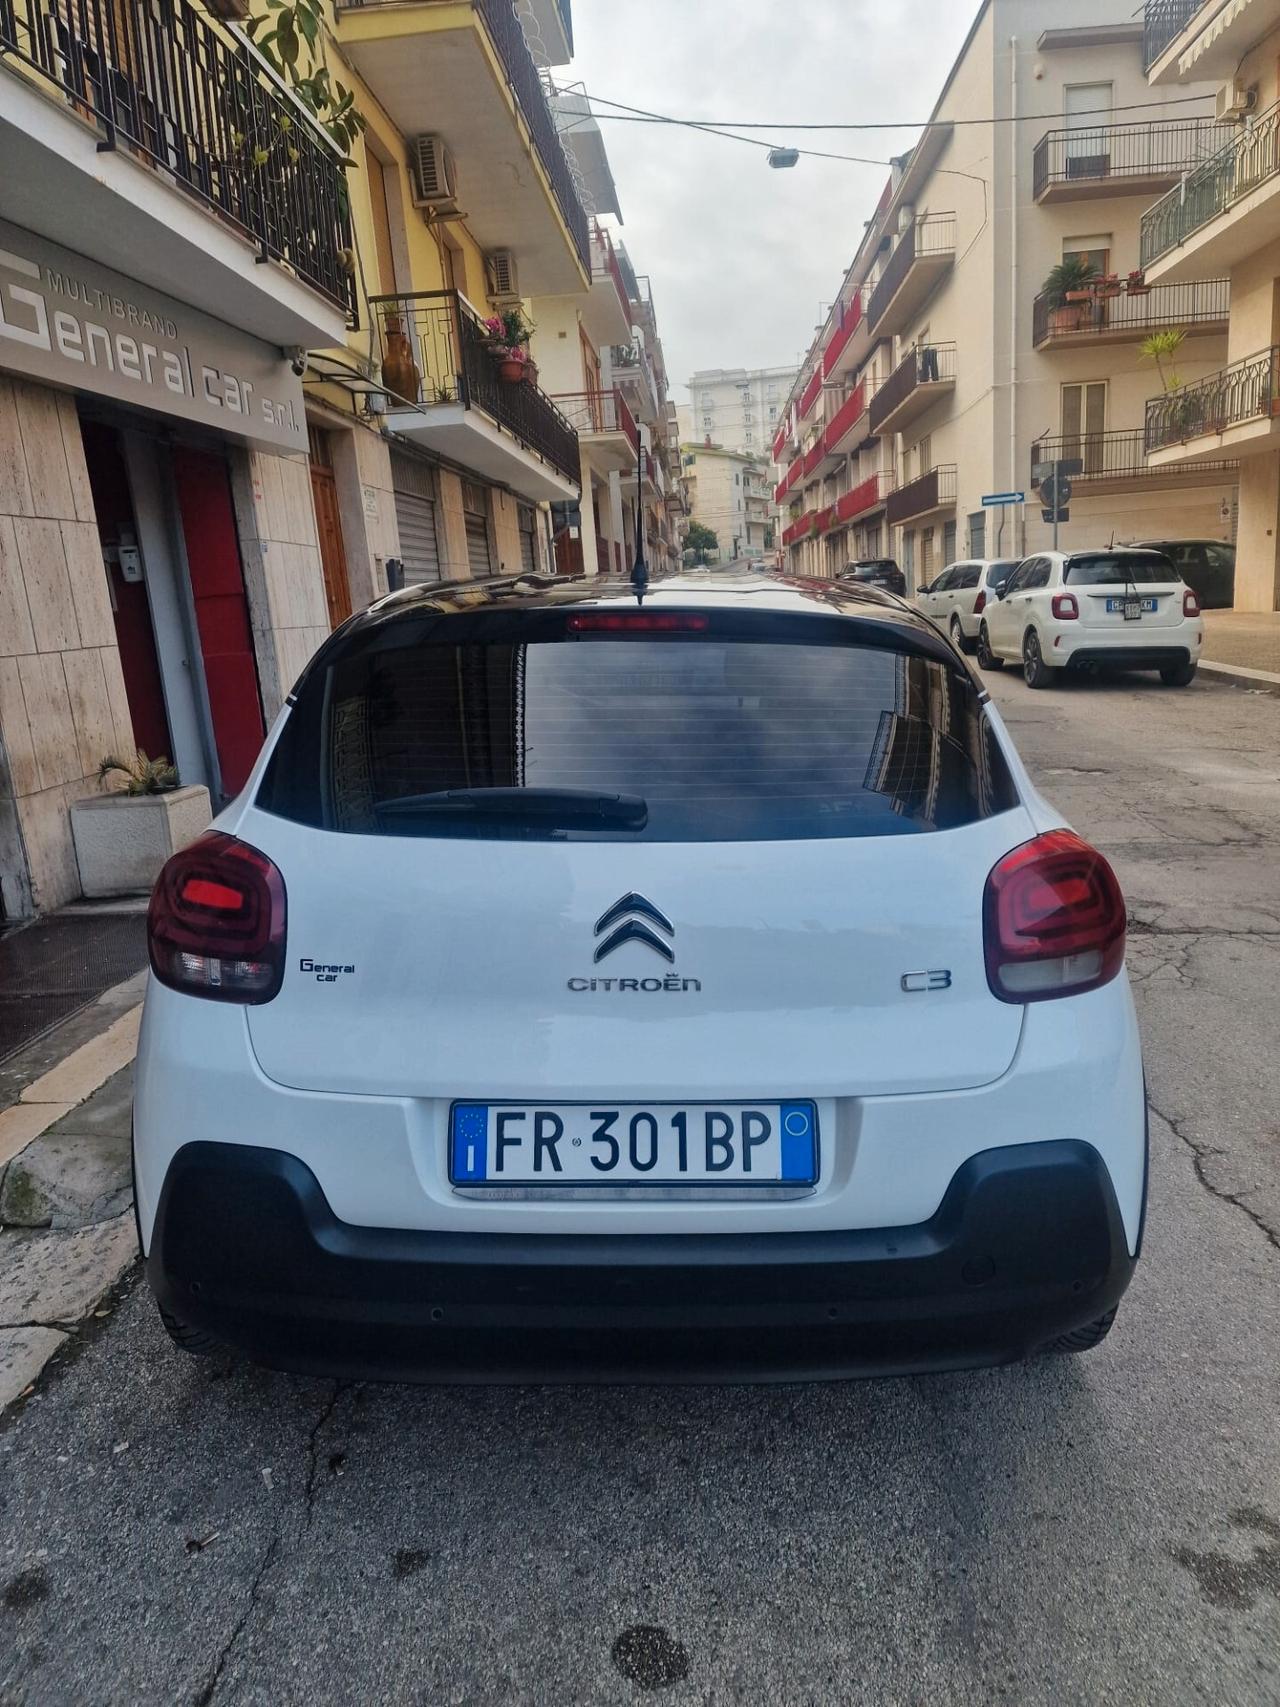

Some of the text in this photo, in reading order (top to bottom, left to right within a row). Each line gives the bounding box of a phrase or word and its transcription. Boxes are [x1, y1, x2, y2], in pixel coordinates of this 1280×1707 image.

[46, 267, 179, 341] MULTIBRAND
[0, 248, 195, 399] General
[202, 364, 254, 417] car
[299, 958, 355, 983] General car
[900, 969, 952, 992] C3
